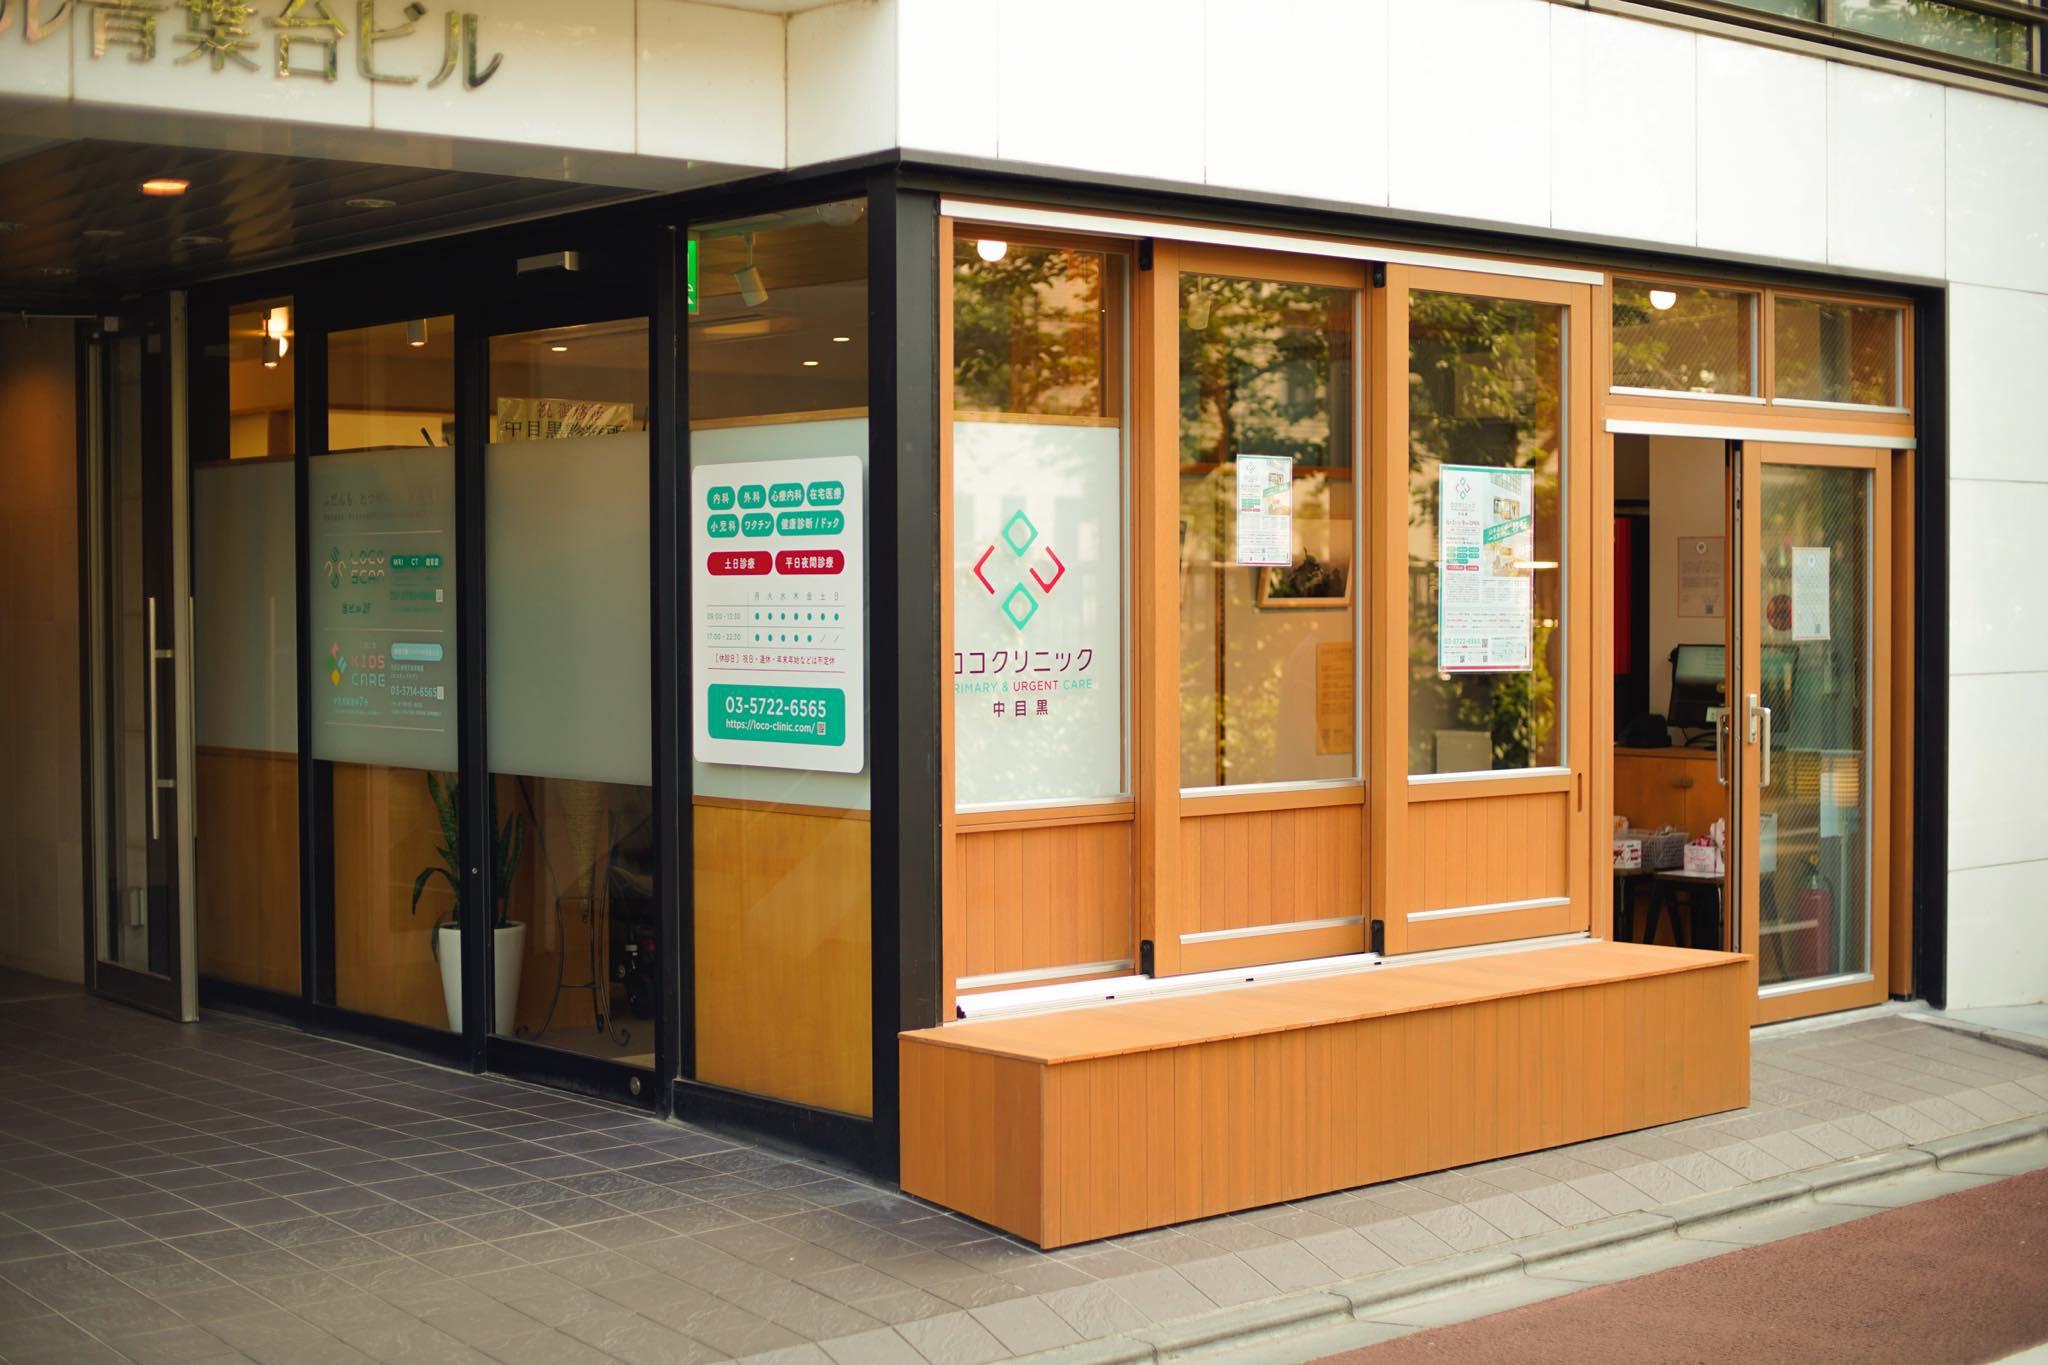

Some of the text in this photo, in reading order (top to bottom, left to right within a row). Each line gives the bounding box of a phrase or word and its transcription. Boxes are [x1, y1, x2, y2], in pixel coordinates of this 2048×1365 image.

[712, 487, 842, 504] 内科 外科 心療内科 在宅医療
[710, 518, 737, 533] 小児科
[744, 519, 772, 532] ワクチン
[723, 556, 835, 570] 土日診療 平日夜間診療
[954, 678, 1093, 693] RIMARY & URGENT CARE
[725, 695, 828, 718] 03-5722-6565
[992, 699, 1049, 718] 中目黒
[725, 718, 816, 734] https://loco-clinic.com/
